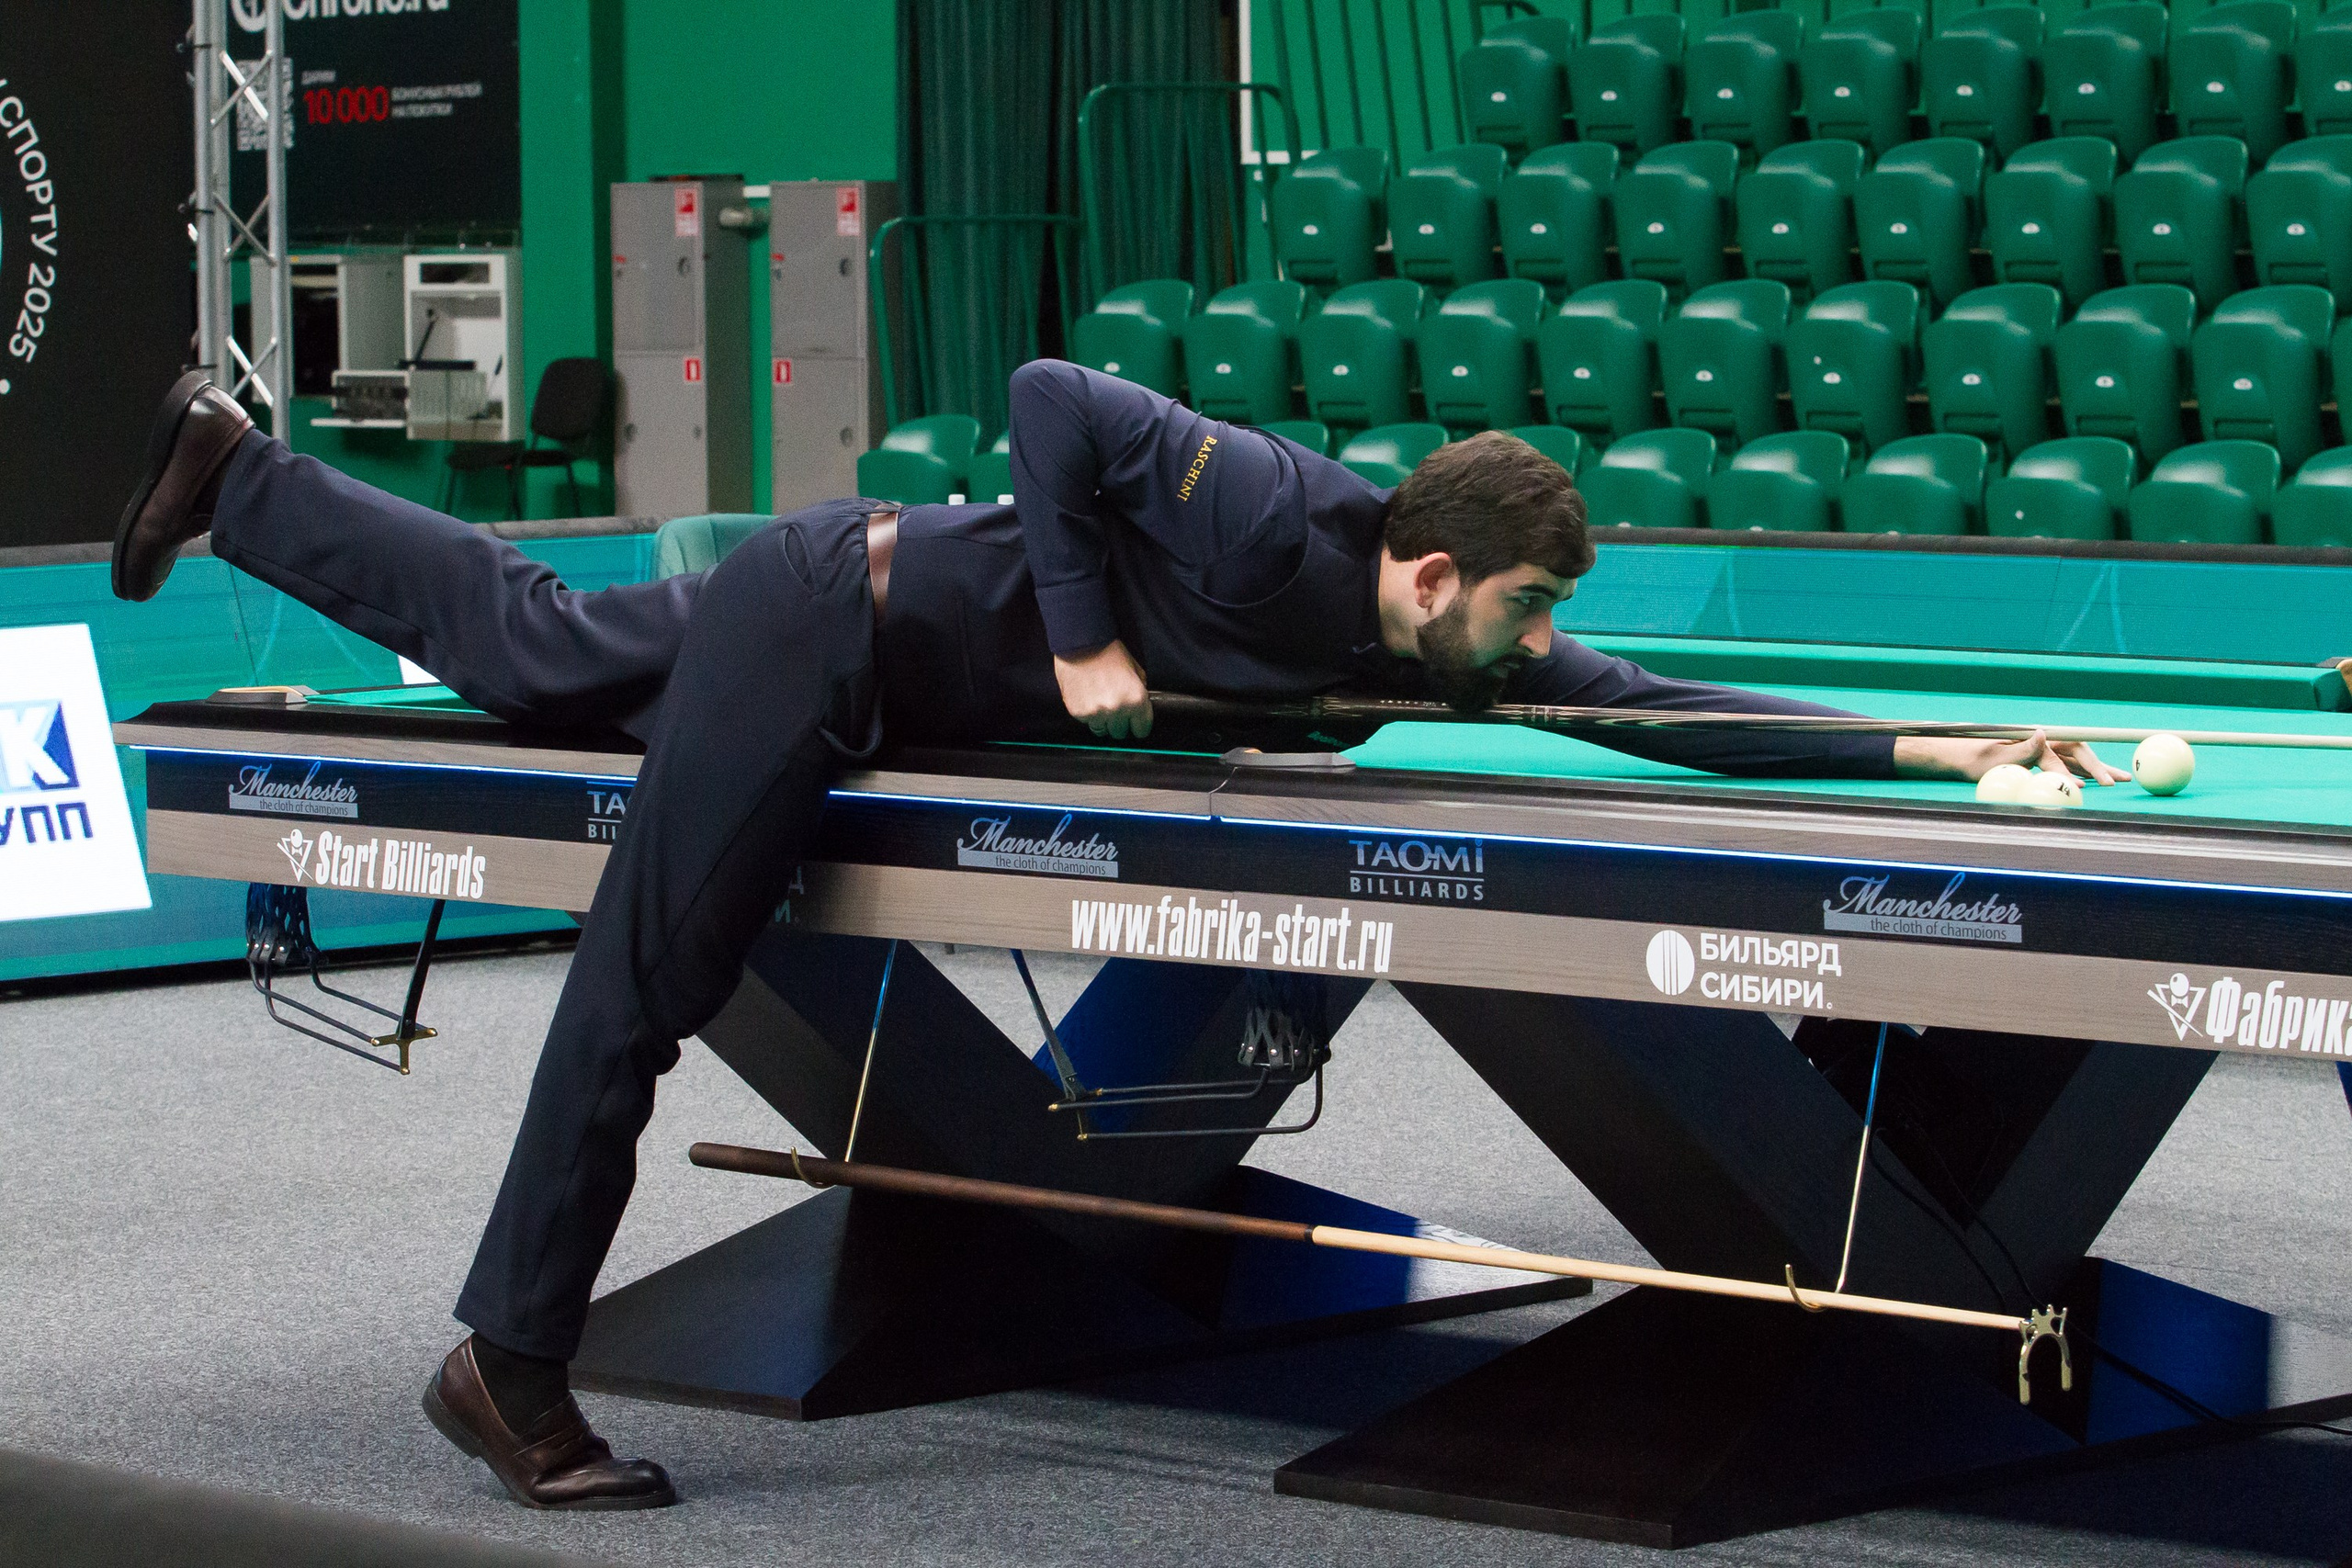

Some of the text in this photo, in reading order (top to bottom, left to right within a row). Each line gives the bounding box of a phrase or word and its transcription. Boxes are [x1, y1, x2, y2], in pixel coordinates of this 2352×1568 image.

[8, 263, 56, 363] 2025
[1177, 434, 1217, 502] RASCHINI
[228, 761, 358, 803] Manchester
[259, 797, 348, 816] the cloth of champions
[956, 813, 1119, 861] Manchester
[315, 830, 486, 899] Start Billiards
[995, 855, 1106, 875] the cloth of champions
[1350, 876, 1485, 901] BILLIARDS
[1823, 872, 2022, 924] Manchester
[1071, 895, 1394, 974] www.fabrika-start.ru
[1871, 919, 2007, 941] the cloth of champions
[1700, 932, 1842, 976] БИЛЬЯРД
